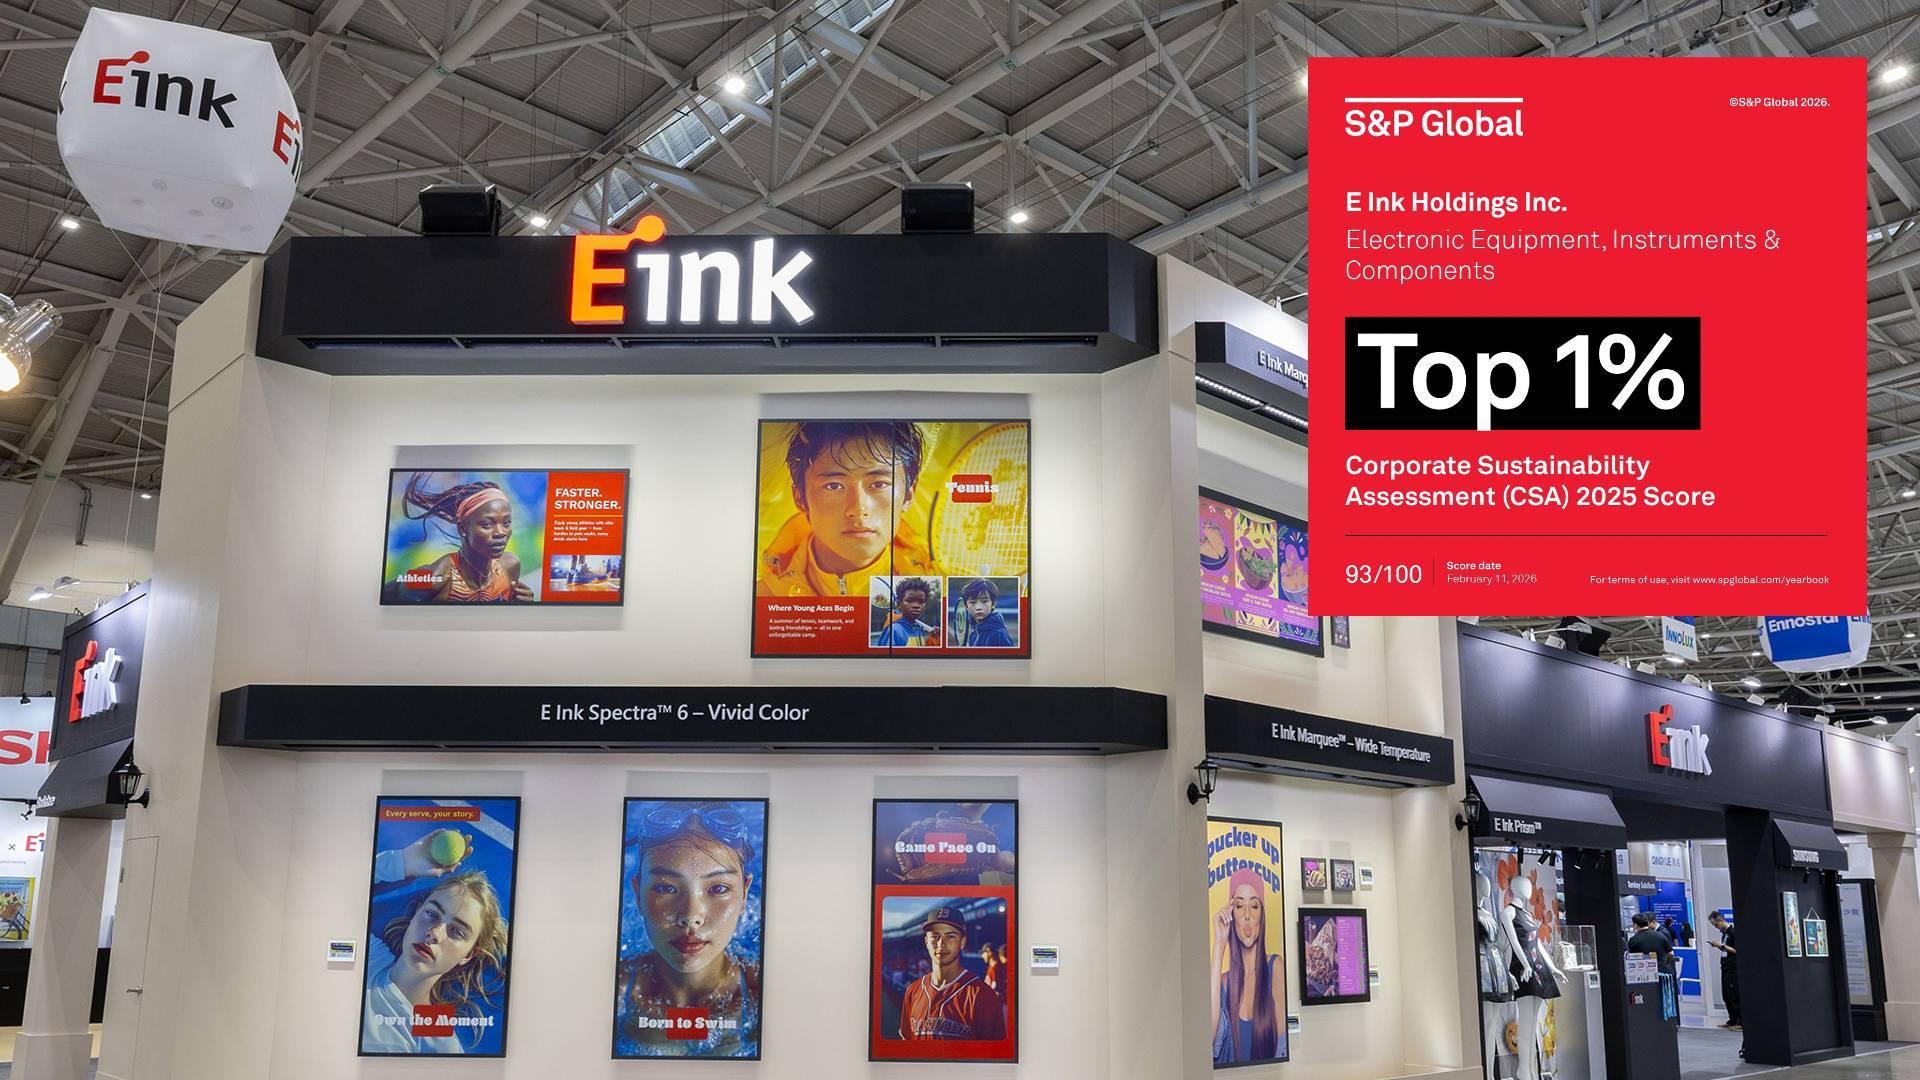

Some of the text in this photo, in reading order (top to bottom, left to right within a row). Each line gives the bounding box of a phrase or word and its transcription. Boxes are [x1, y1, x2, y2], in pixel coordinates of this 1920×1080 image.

[1258, 350, 1266, 366] E
[1266, 353, 1283, 373] Ink
[555, 488, 602, 497] FASTER.
[945, 481, 999, 493] Tennis
[554, 500, 622, 510] STRONGER.
[396, 574, 442, 583] Athletics
[540, 704, 551, 720] E
[556, 704, 584, 720] Ink
[677, 704, 689, 720] 6
[708, 703, 754, 720] Vivid
[758, 703, 810, 720] Color
[1271, 723, 1279, 738] E
[1280, 724, 1296, 741] Ink
[1354, 737, 1379, 754] Wide
[1379, 741, 1431, 762] Temperature
[386, 810, 408, 818] Every
[1494, 818, 1501, 831] E
[1502, 819, 1515, 832] Ink
[895, 841, 996, 853] Game Face On
[1208, 826, 1280, 866] pucker up
[375, 1014, 494, 1027] Own the Moment
[638, 1017, 737, 1029] Born to Swim
